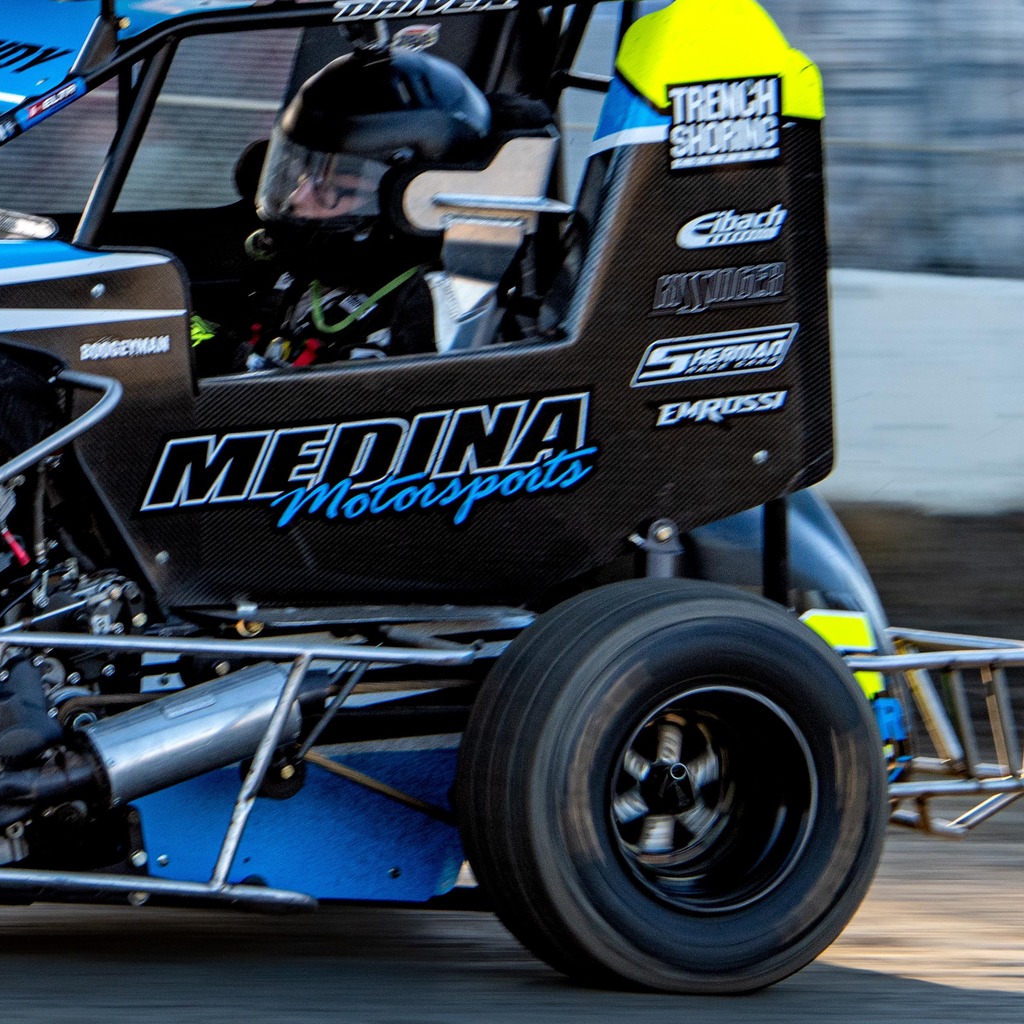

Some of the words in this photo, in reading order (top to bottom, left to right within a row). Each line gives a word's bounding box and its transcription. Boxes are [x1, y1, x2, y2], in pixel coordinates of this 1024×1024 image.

[668, 78, 779, 125] TRENCH
[669, 116, 780, 159] SHORING
[676, 203, 788, 249] Eibach
[637, 330, 791, 380] SHERMAN
[655, 390, 788, 426] EMROSSI
[140, 391, 591, 512] MEDINA
[271, 446, 598, 527] Motorsports
